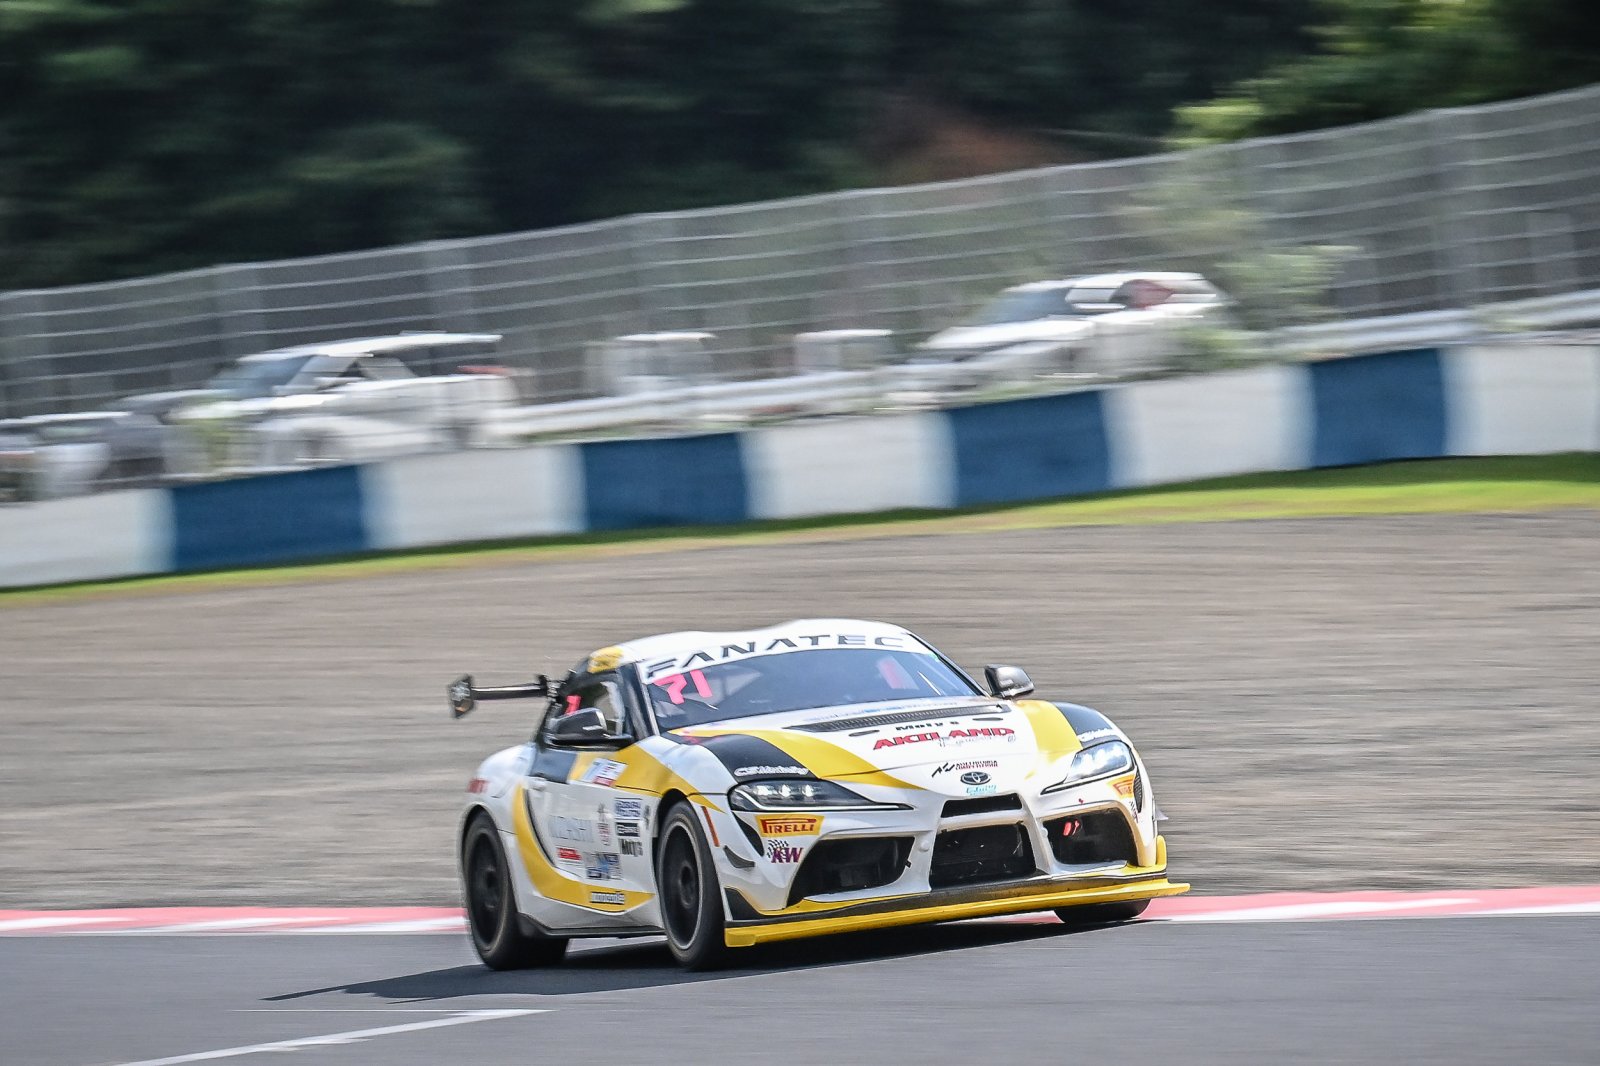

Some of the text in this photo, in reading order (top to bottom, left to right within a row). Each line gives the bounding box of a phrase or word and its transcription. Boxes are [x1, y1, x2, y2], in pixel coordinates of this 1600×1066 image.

[647, 634, 903, 678] FANATEC
[653, 669, 713, 705] 71
[872, 727, 1015, 751] AKILAND
[760, 818, 817, 833] PIRELLI
[771, 847, 804, 863] KW
